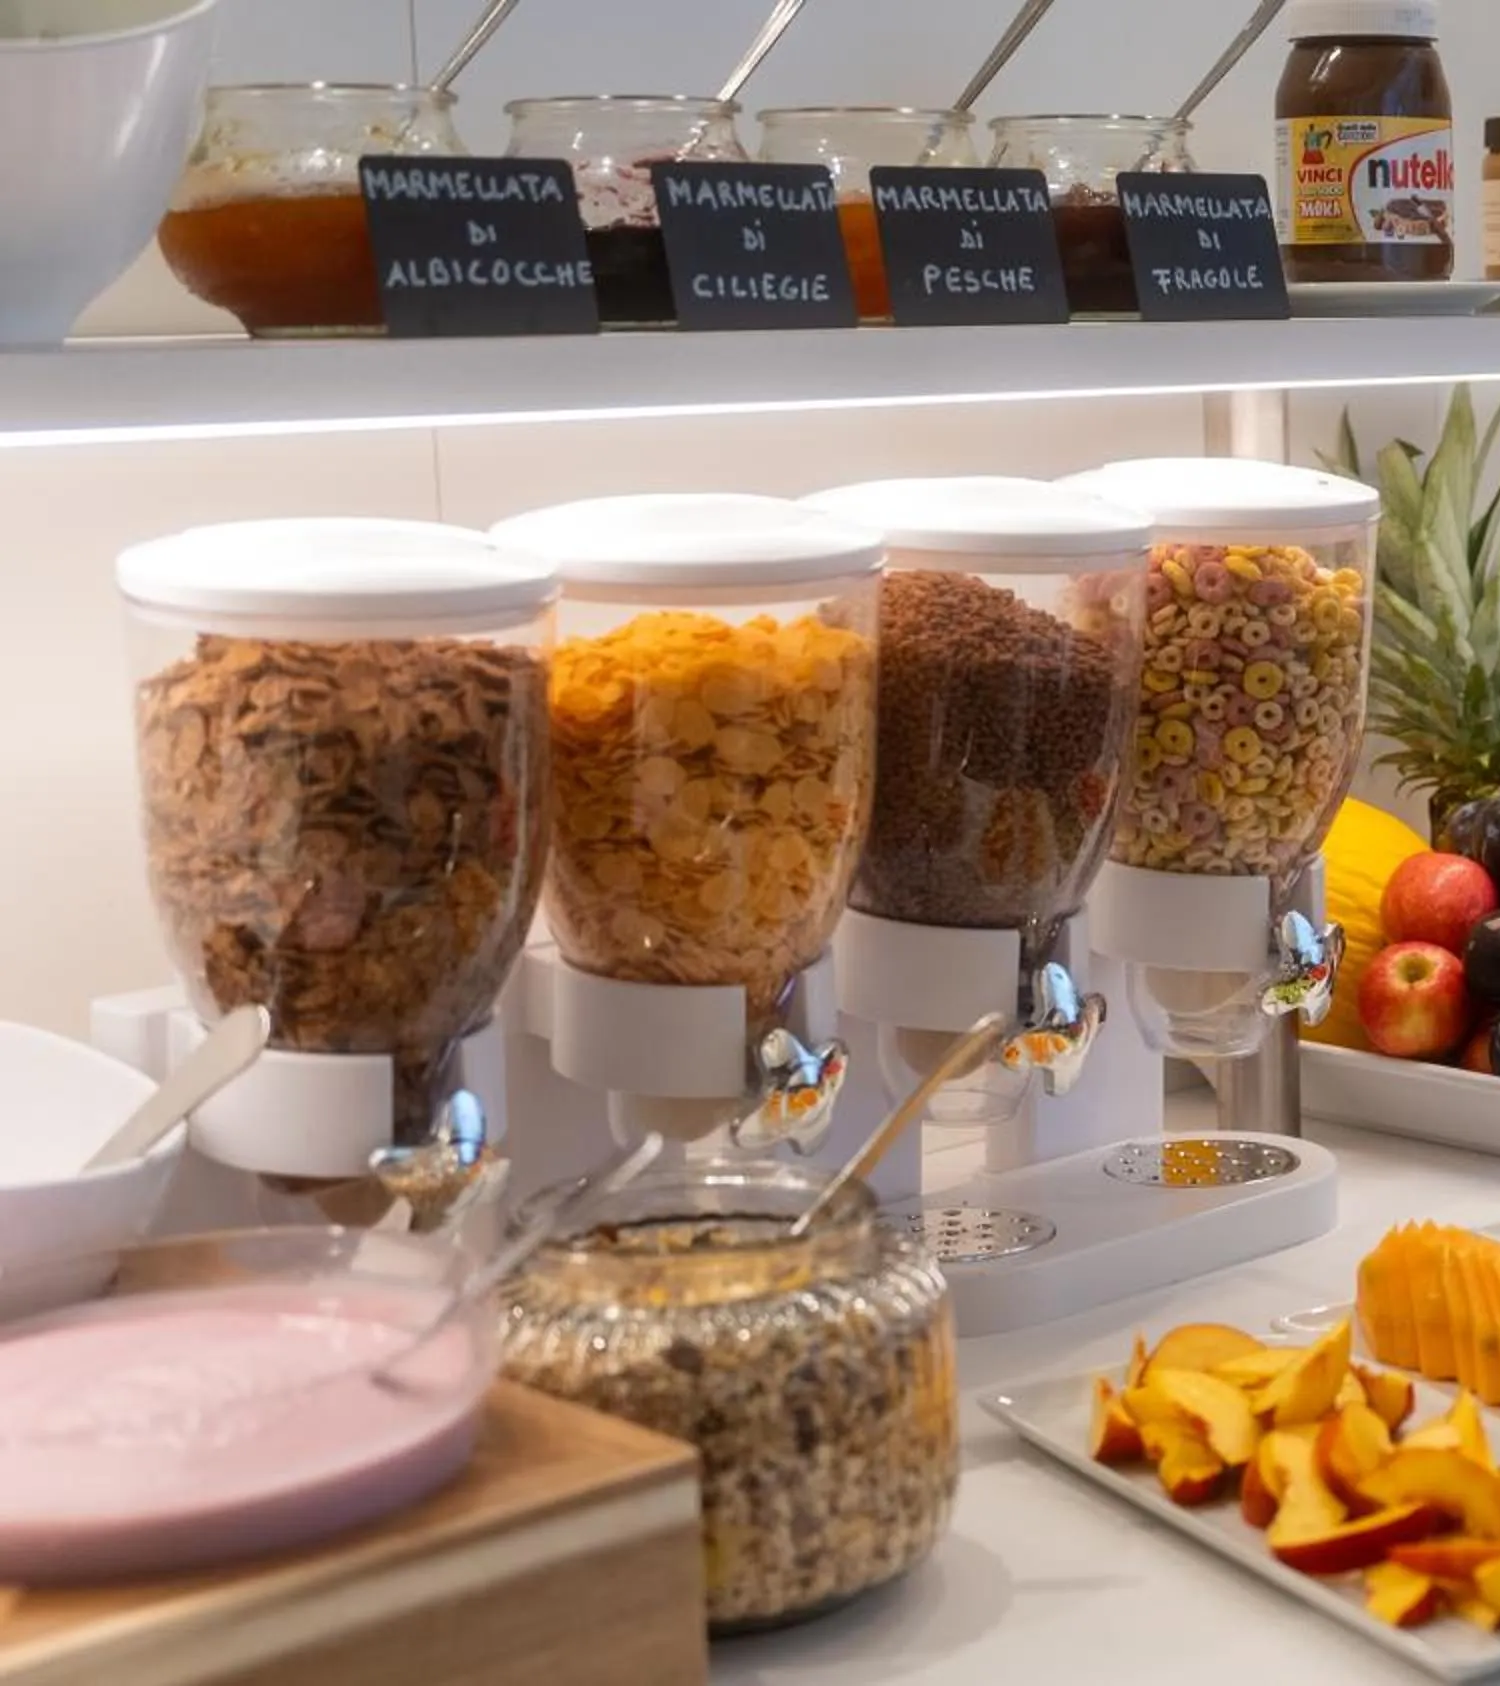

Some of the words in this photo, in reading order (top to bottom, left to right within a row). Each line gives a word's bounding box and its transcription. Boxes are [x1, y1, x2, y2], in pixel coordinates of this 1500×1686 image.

[365, 168, 563, 201] MARMELLATA
[1296, 167, 1343, 183] VINCI
[876, 186, 1048, 213] MARMELLATA
[1121, 192, 1271, 220] MARMELLATA
[467, 221, 497, 245] DI
[1199, 229, 1221, 251] DI
[386, 260, 595, 288] ALBICOCCHE
[692, 272, 830, 301] CILIEGIE
[923, 264, 1035, 294] PESCHE
[1152, 266, 1264, 294] FRAGOLE
